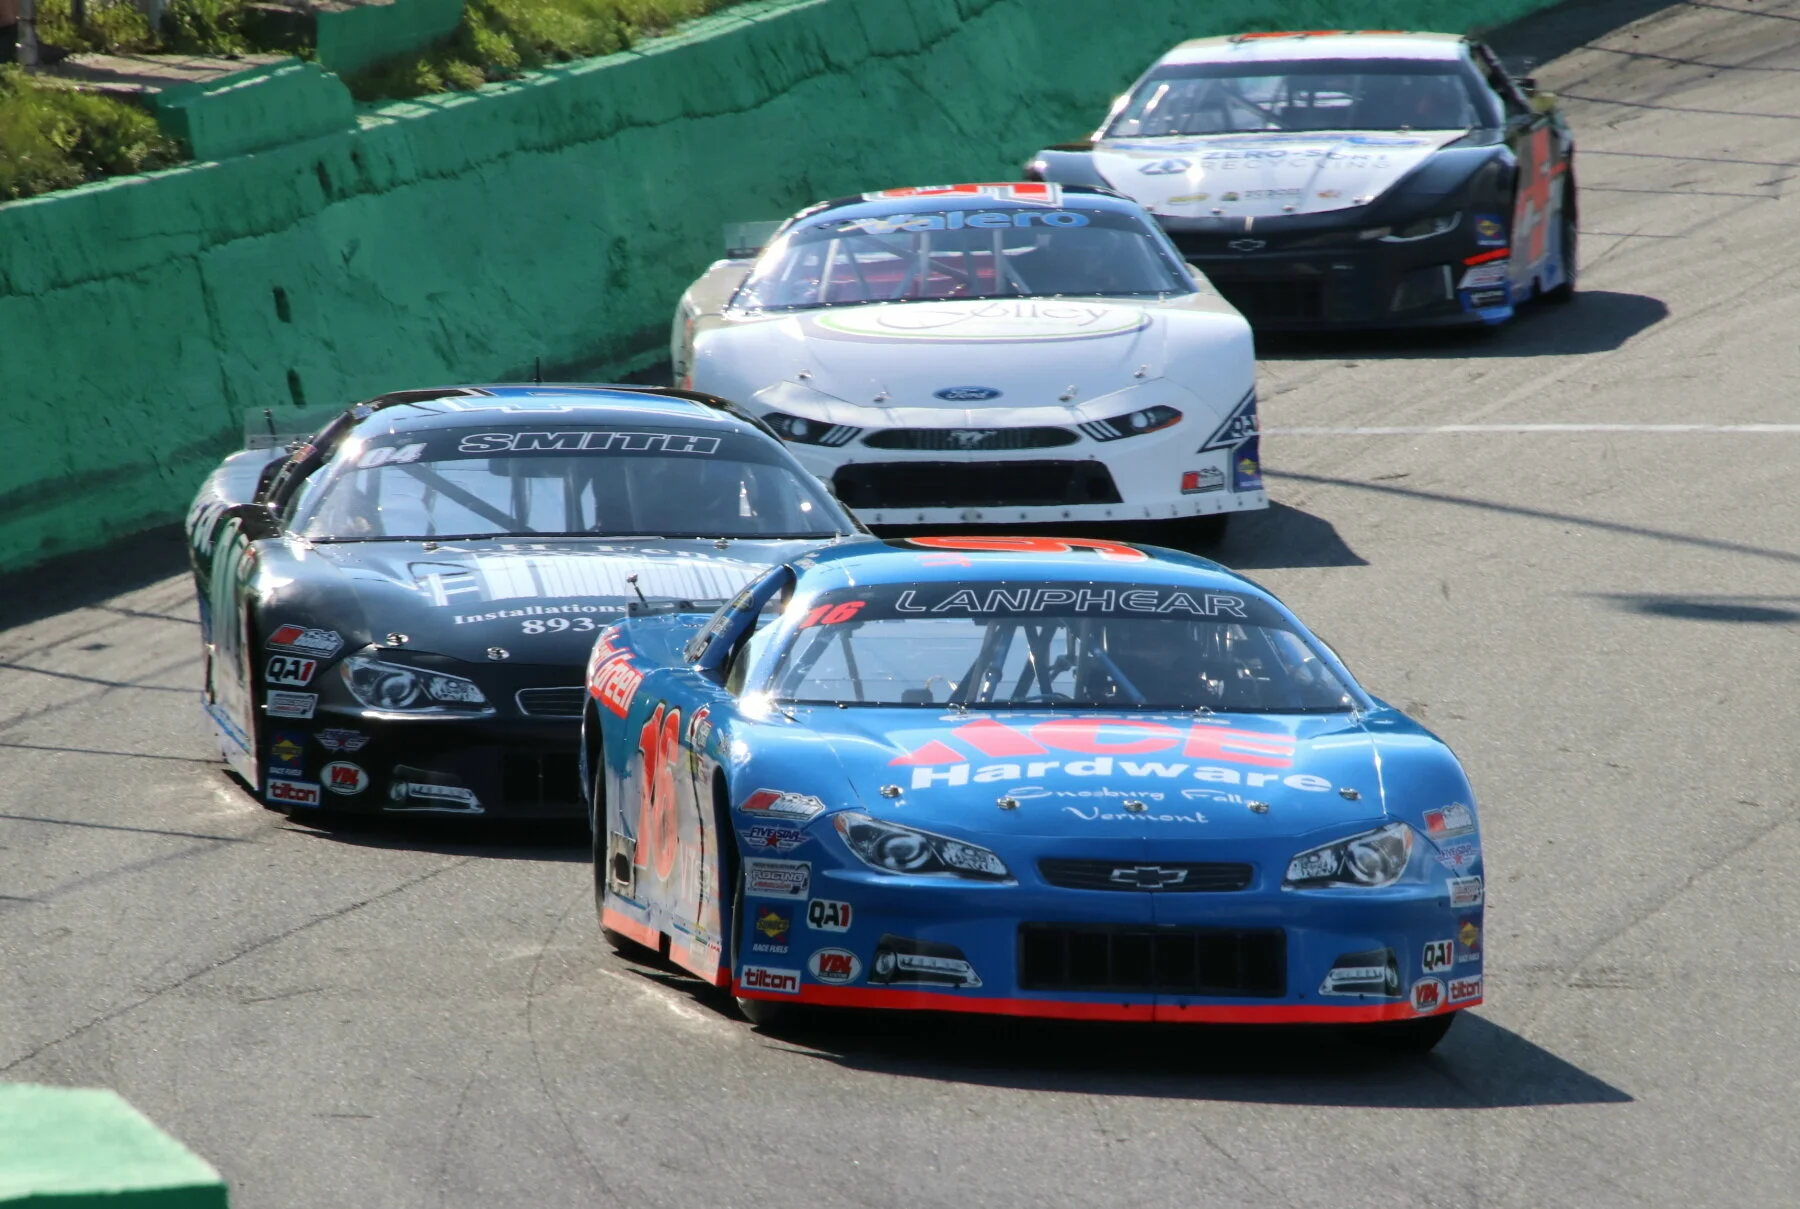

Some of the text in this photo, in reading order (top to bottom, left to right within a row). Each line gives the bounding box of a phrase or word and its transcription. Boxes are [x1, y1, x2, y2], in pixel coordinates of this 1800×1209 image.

[459, 431, 721, 455] SMITH
[453, 603, 626, 625] Installations
[799, 600, 867, 629] 16
[895, 588, 1248, 618] LANPHEAR
[267, 657, 315, 682] QA1
[887, 718, 1297, 769] ACE
[911, 757, 1333, 792] Hardware
[270, 781, 317, 803] tilton
[634, 702, 680, 882] 16
[1181, 788, 1249, 805] Fall
[1061, 805, 1209, 824] Vermont
[808, 900, 850, 929] QA1
[1423, 941, 1453, 971] QA1
[744, 968, 797, 990] tilton
[1451, 980, 1481, 1000] tilton
